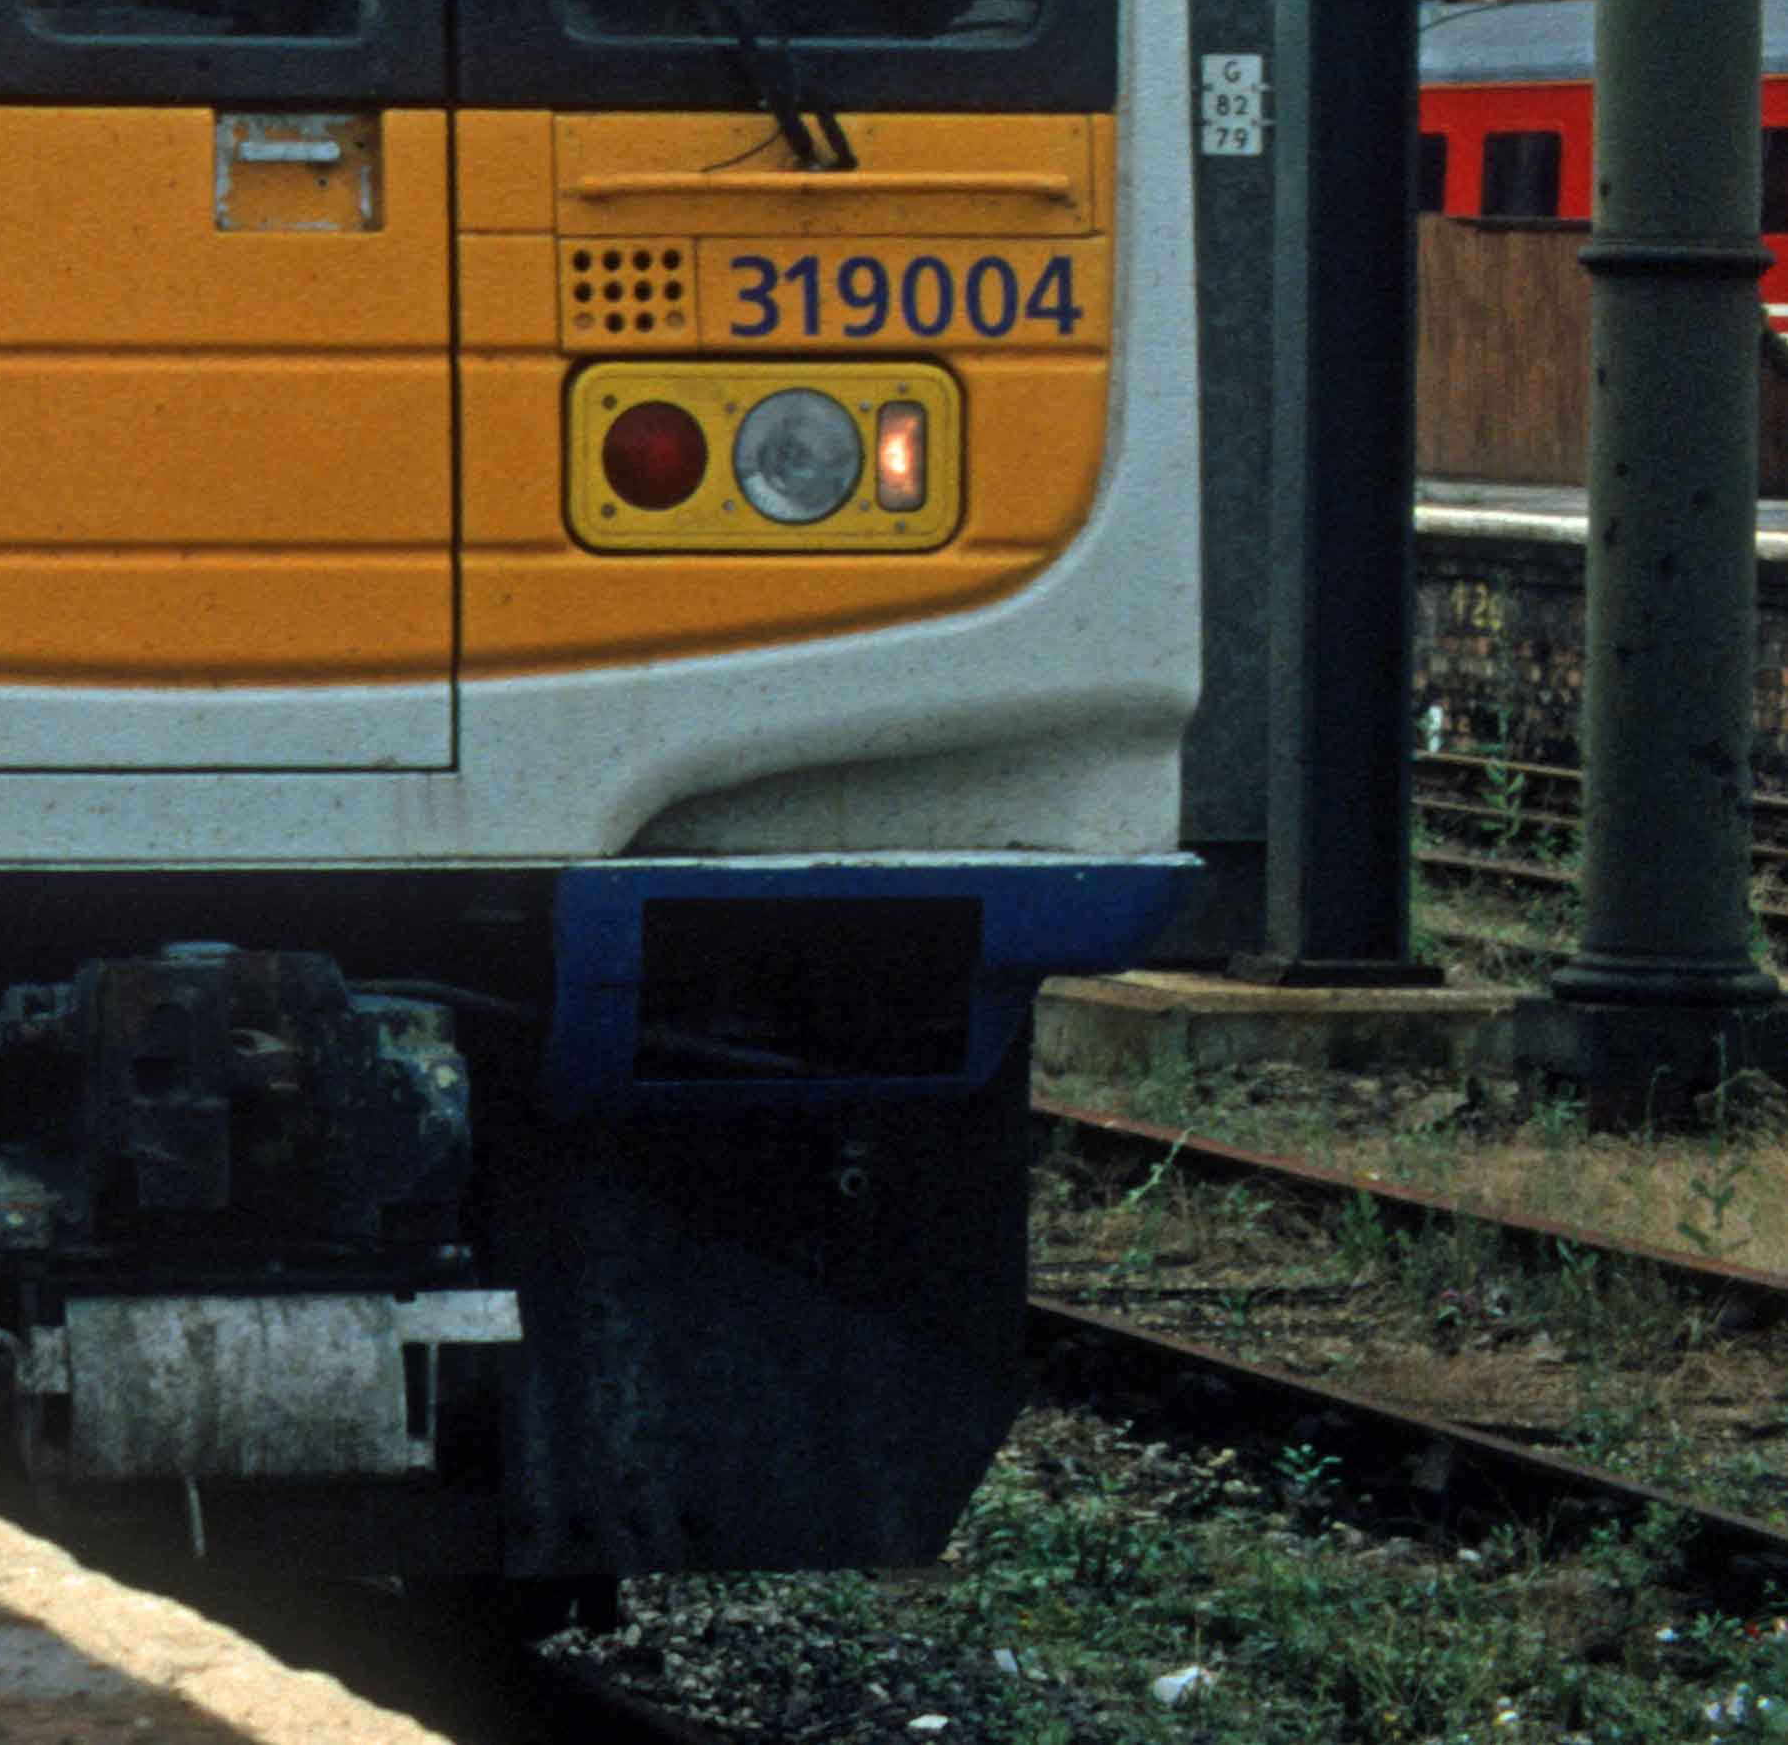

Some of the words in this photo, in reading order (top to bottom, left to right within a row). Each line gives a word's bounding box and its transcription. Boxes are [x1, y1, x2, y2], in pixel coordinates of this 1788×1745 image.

[1216, 94, 1249, 116] 82
[1216, 127, 1249, 149] 79
[729, 254, 1083, 338] 319004
